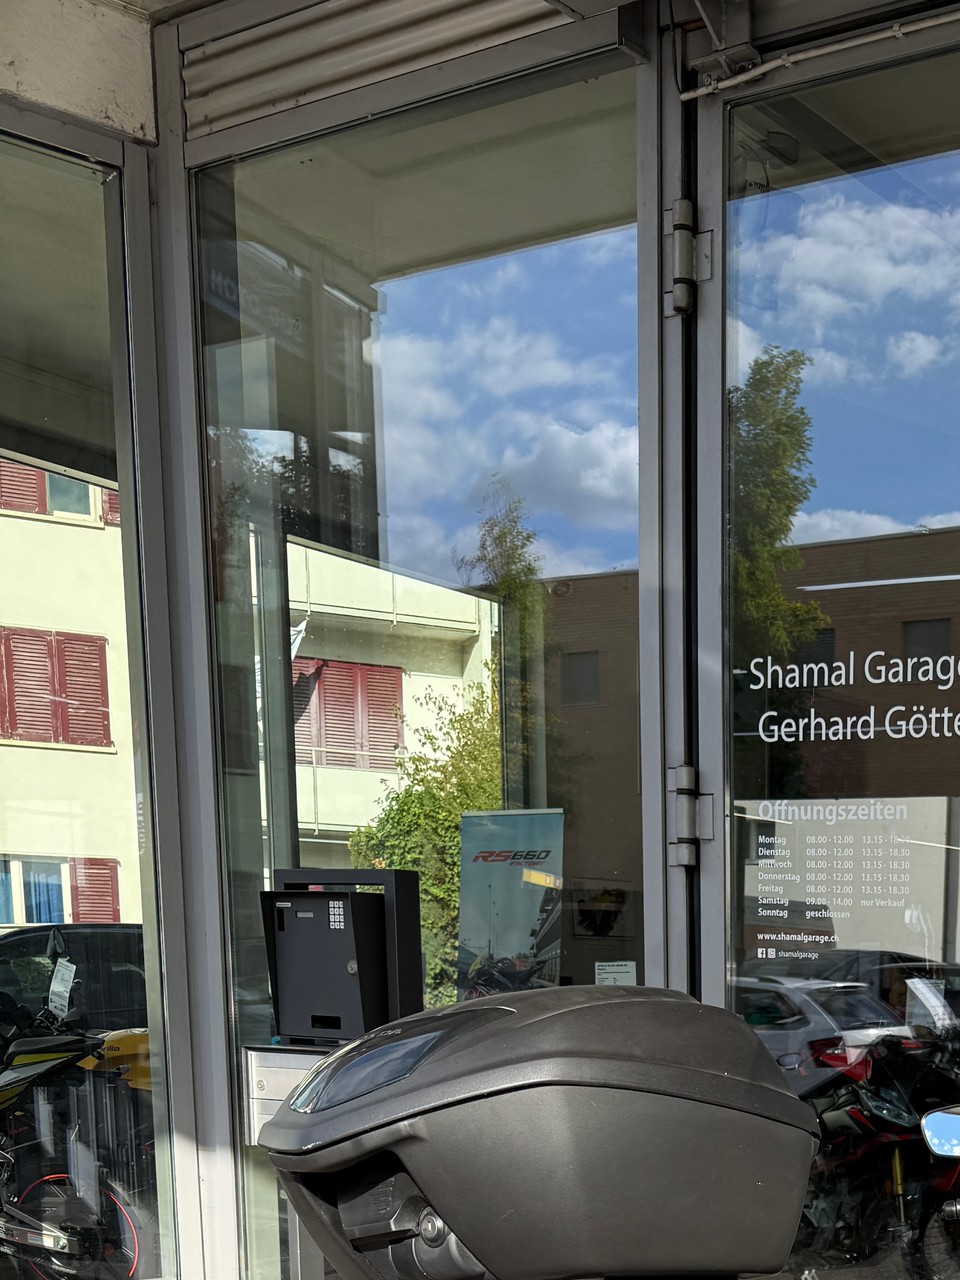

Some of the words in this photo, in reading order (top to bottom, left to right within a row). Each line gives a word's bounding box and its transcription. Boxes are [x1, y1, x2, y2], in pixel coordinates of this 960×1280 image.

[750, 651, 854, 690] Shamal
[758, 706, 875, 743] Gerhard
[758, 835, 787, 846] Montag
[806, 836, 827, 844] 08.00
[833, 836, 854, 844] 12.00
[862, 836, 883, 844] 13.15
[472, 850, 552, 863] RS660
[758, 847, 791, 858] Dienstag
[806, 848, 827, 856] 08.00
[833, 848, 854, 856] 12.00
[862, 848, 883, 857] 13.15
[889, 848, 910, 857] 18.30
[806, 860, 827, 869] 08.00
[833, 860, 853, 869] 12.00
[862, 861, 883, 869] 13.15
[889, 861, 910, 869] 18.30
[758, 872, 800, 883] Donnerstag
[806, 873, 826, 881] 08.00
[832, 873, 853, 881] 12.00
[862, 873, 882, 882] 13.15
[888, 873, 910, 882] 18.30
[758, 884, 784, 894] Freitag
[805, 885, 826, 893] 08.00
[832, 885, 853, 893] 12.00
[861, 886, 882, 894] 13.15
[888, 886, 909, 894] 18.30
[758, 896, 789, 906] Samstag
[805, 898, 827, 906] 09.00
[832, 898, 853, 906] 14.00
[875, 899, 905, 907] Verkauf
[758, 908, 788, 918] Sonntag
[805, 909, 850, 919] geschlossen
[757, 932, 839, 944] www.shamalgarage.ch
[778, 950, 819, 960] shamalgarage
